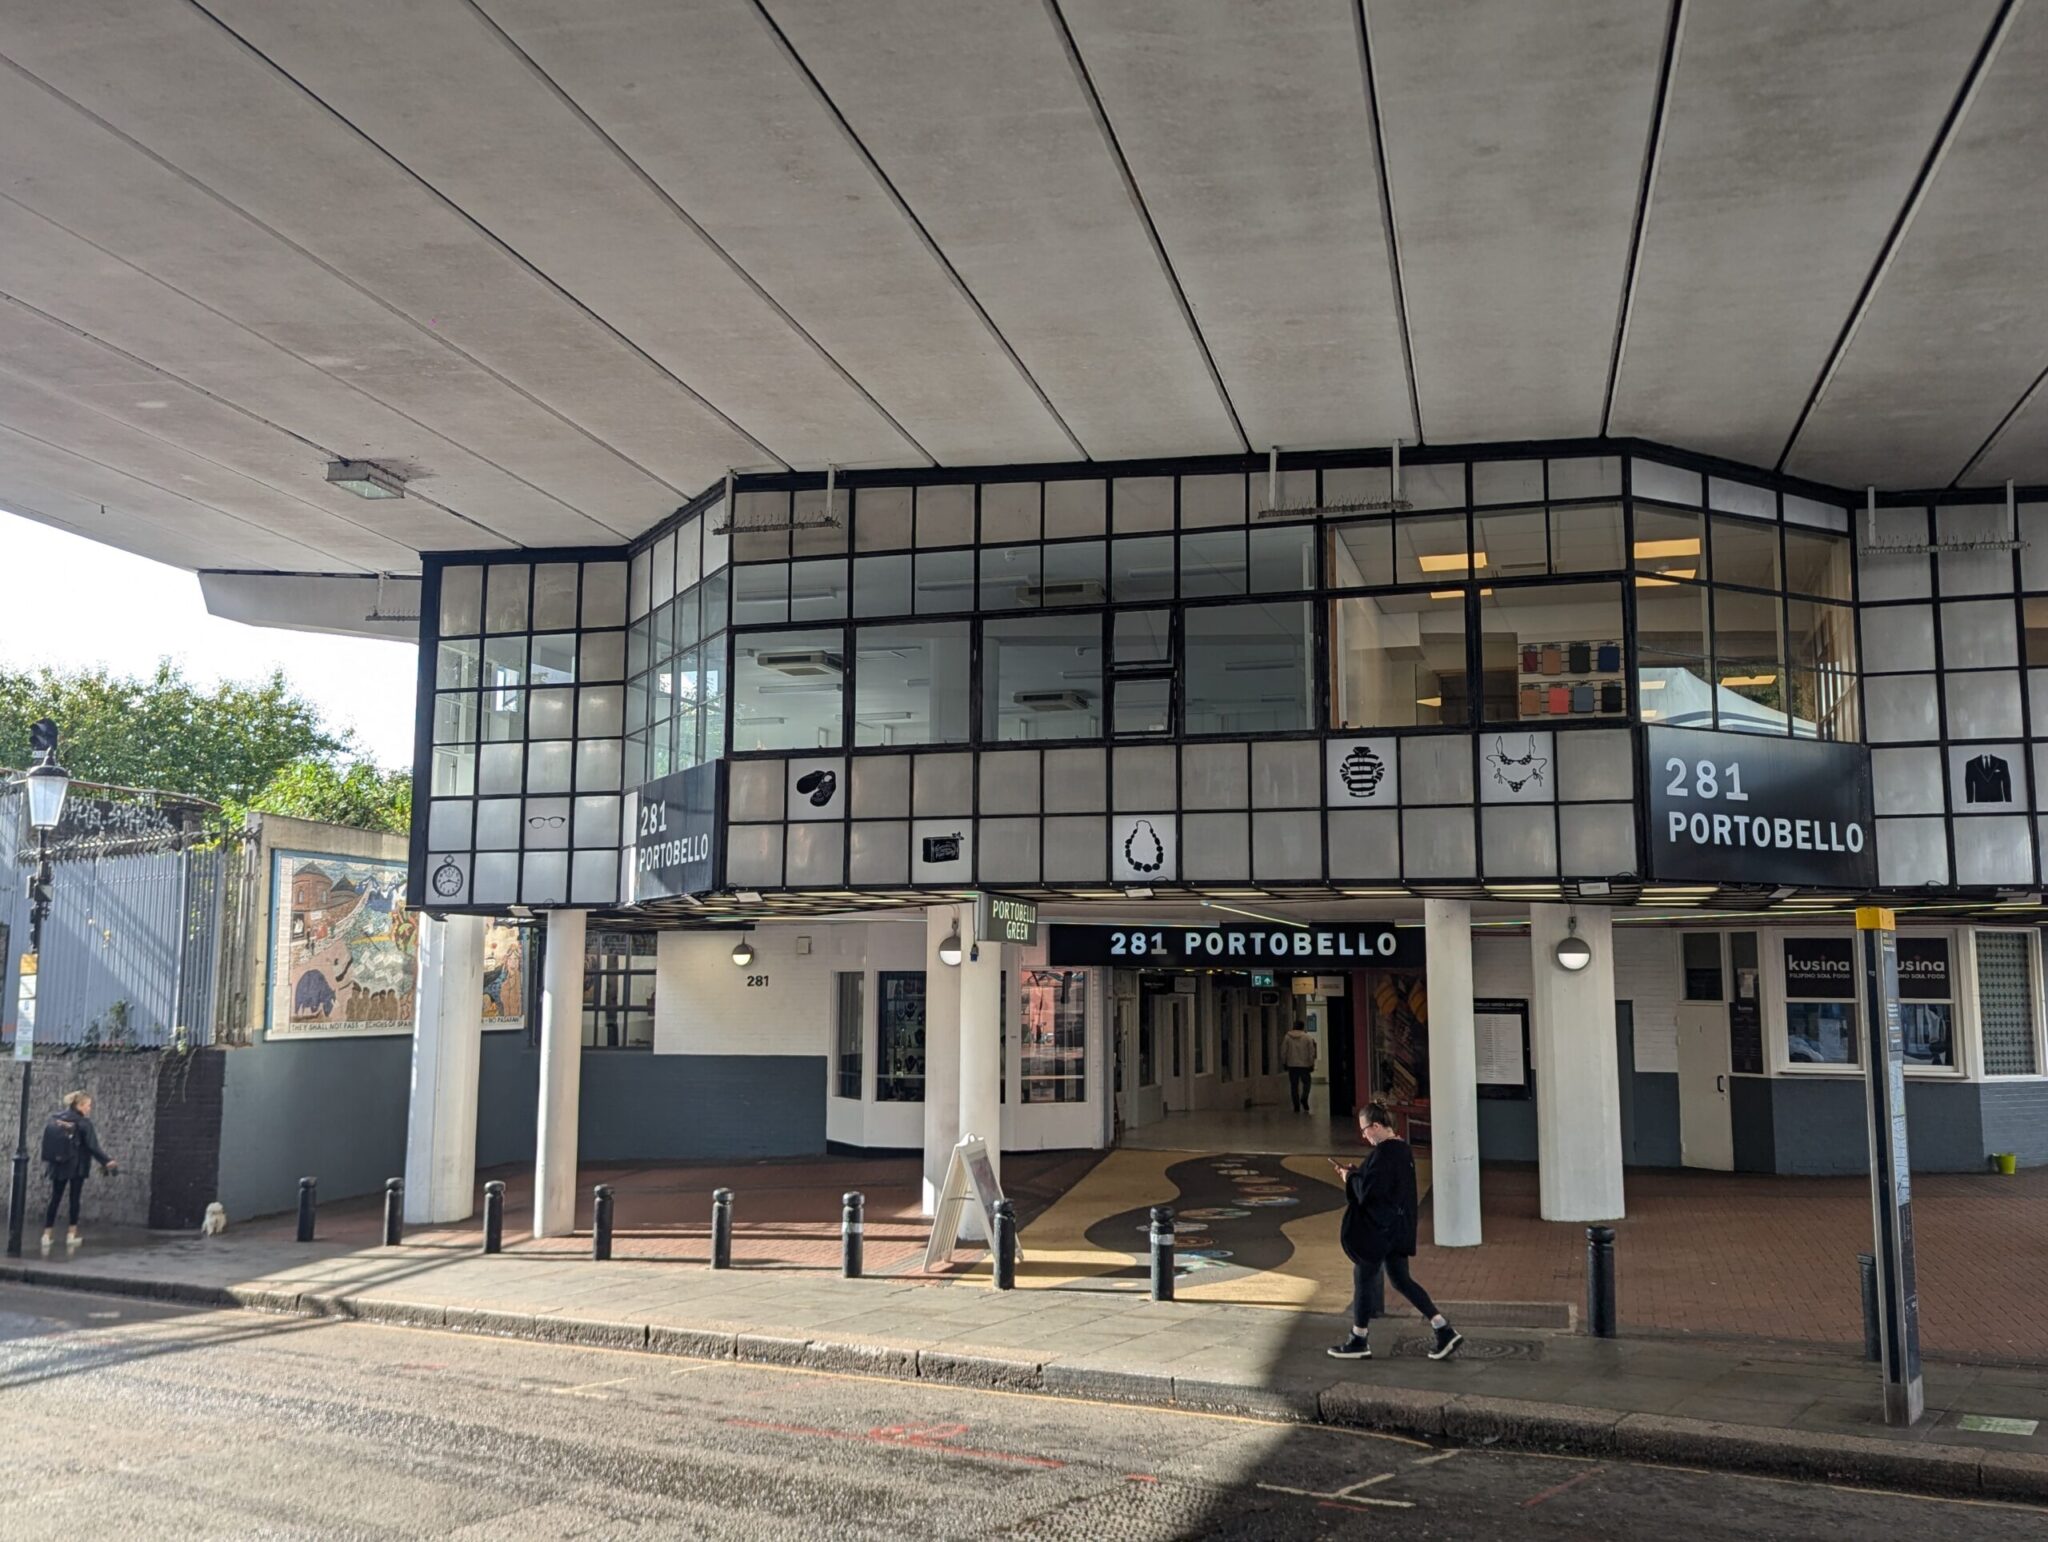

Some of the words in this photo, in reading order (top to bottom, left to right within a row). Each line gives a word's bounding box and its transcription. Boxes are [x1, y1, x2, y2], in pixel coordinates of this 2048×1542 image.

[1665, 757, 1749, 801] 281
[640, 800, 667, 836] 281
[1668, 811, 1864, 853] PORTOBELLO
[639, 833, 709, 873] PORTOBELLO
[992, 900, 1036, 924] PORTOBELLO
[1006, 920, 1029, 940] GREEN
[1110, 932, 1168, 955] 281
[1184, 932, 1397, 956] PORTOBELLO
[1788, 954, 1850, 971] kusina
[1897, 955, 1945, 971] usina
[746, 975, 769, 987] 281
[343, 1021, 359, 1029] PASS
